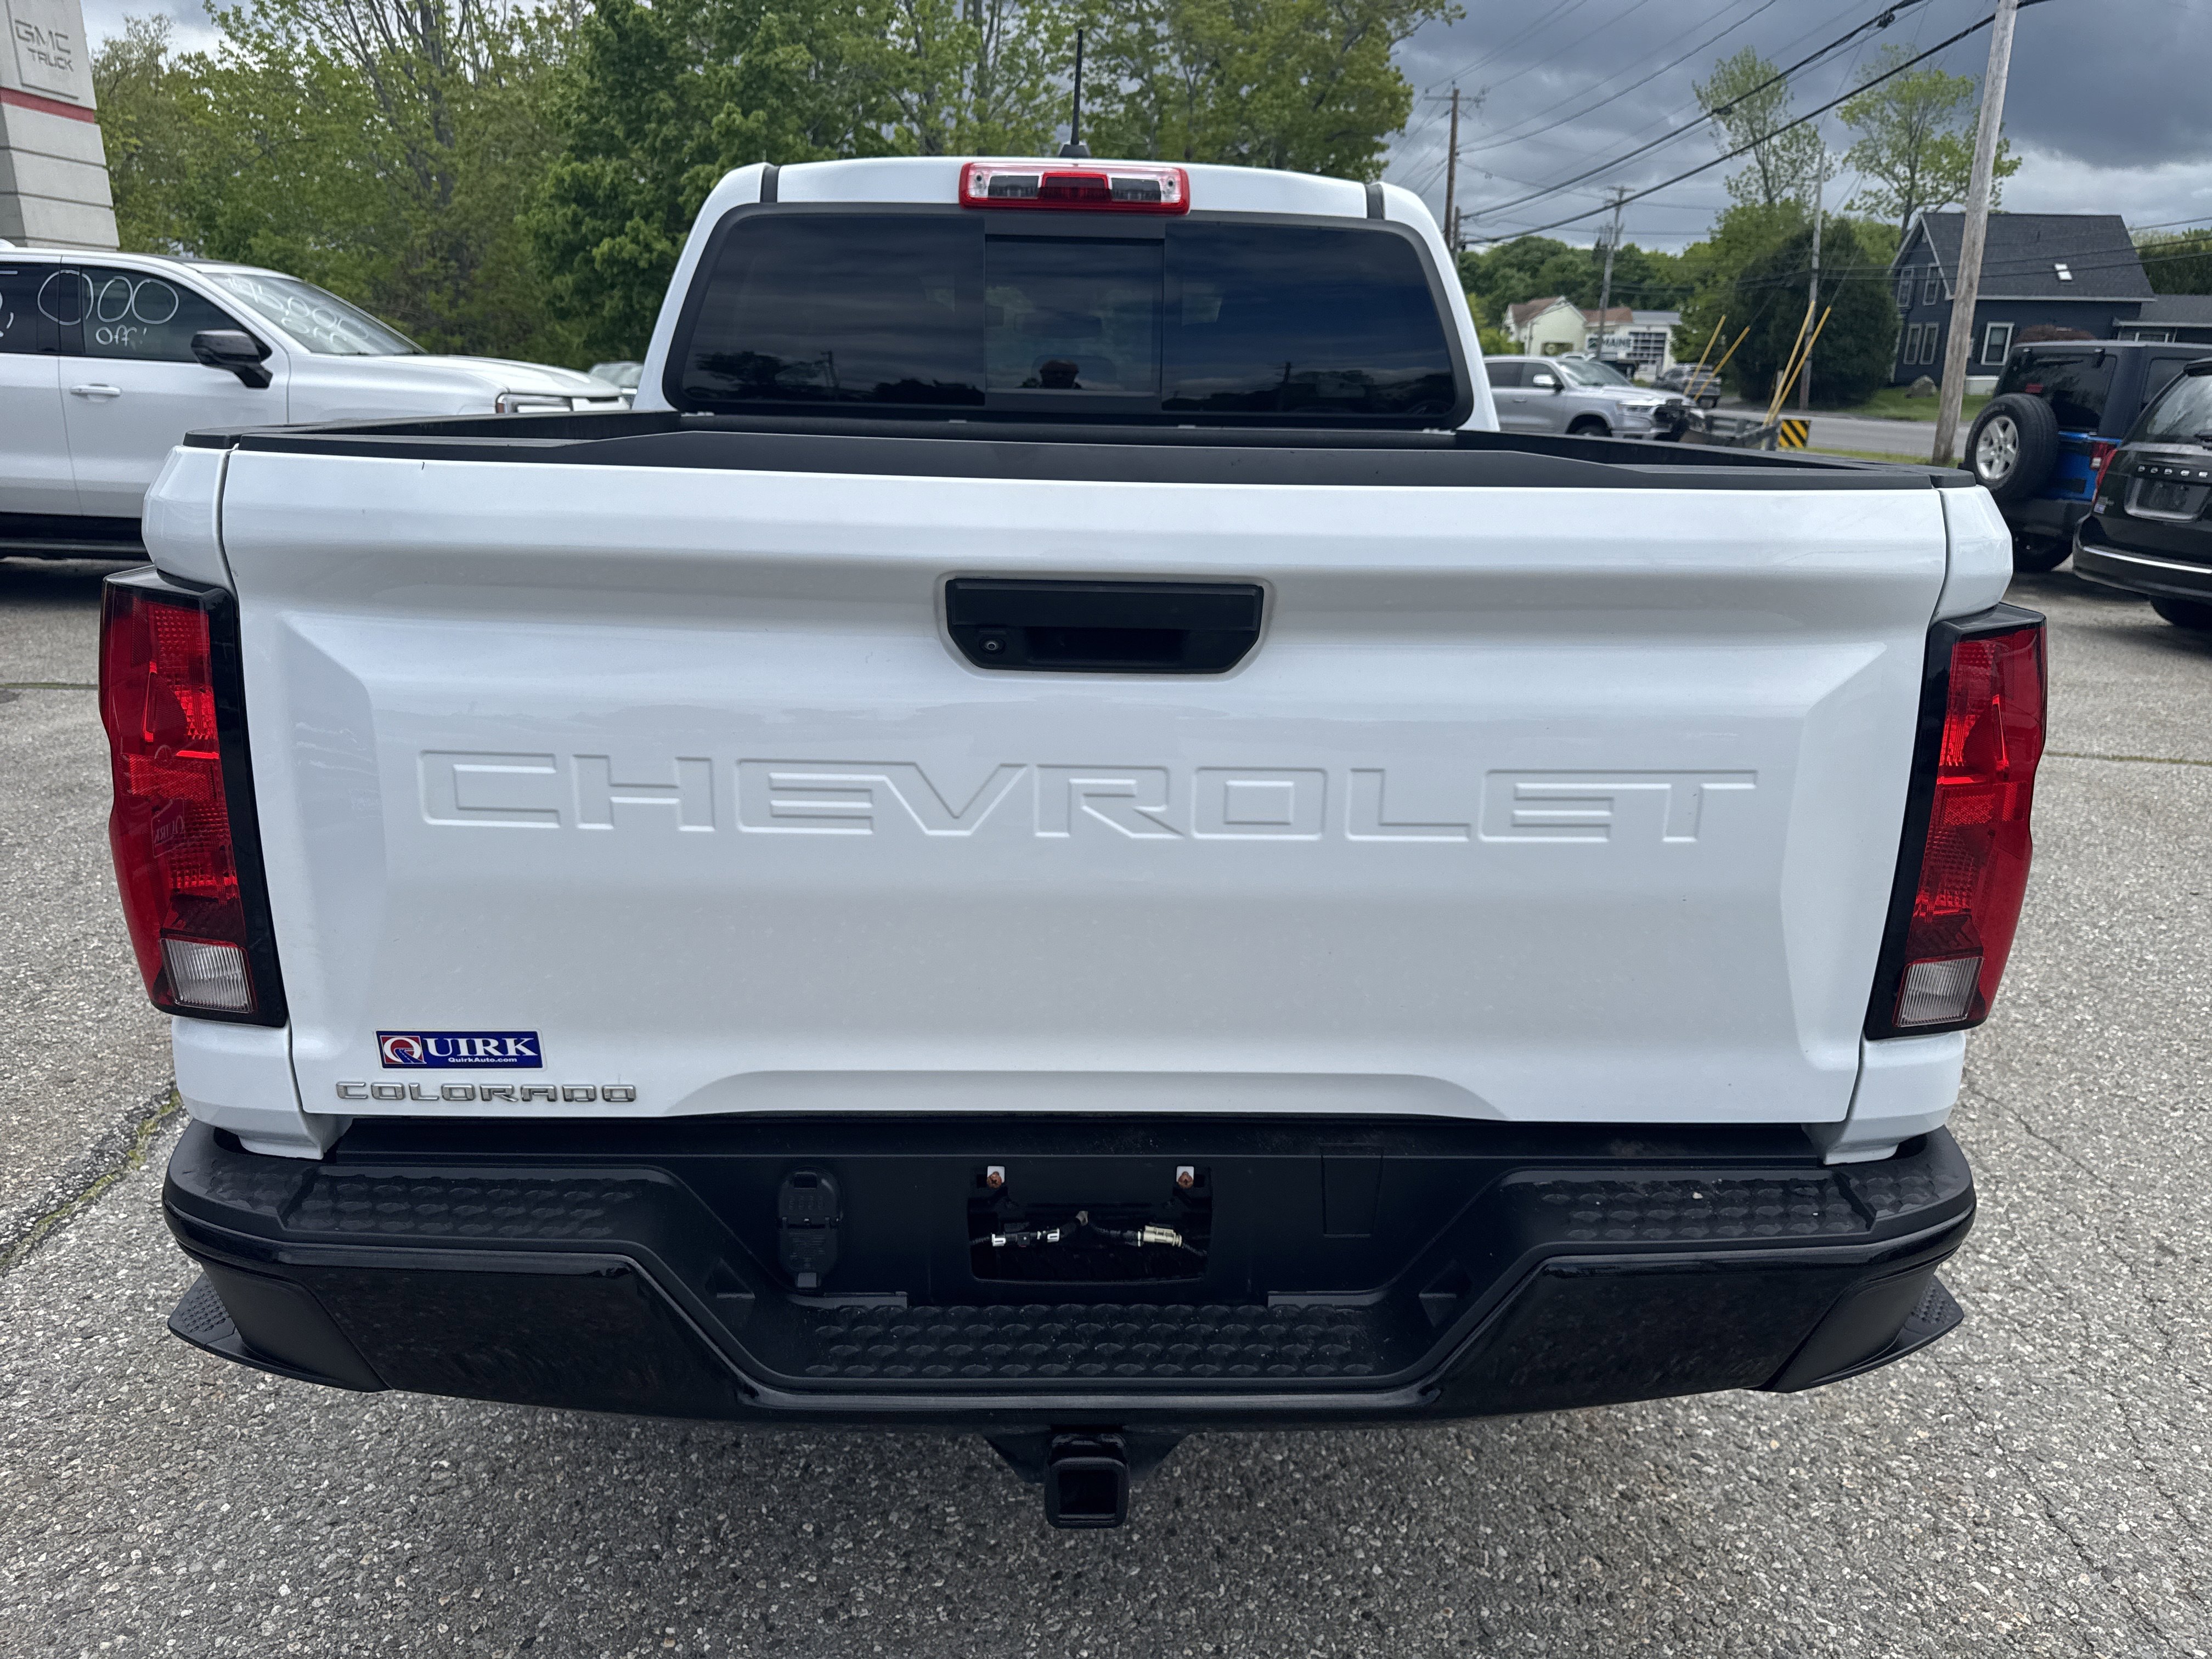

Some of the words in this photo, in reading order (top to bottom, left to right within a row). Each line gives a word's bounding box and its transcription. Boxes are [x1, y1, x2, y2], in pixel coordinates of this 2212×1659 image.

[15, 19, 71, 54] GMC
[27, 47, 74, 72] TRUCK
[418, 749, 1758, 844] CHEVROLET
[383, 1036, 538, 1064] QUIRK
[336, 1081, 636, 1102] COLORADO
